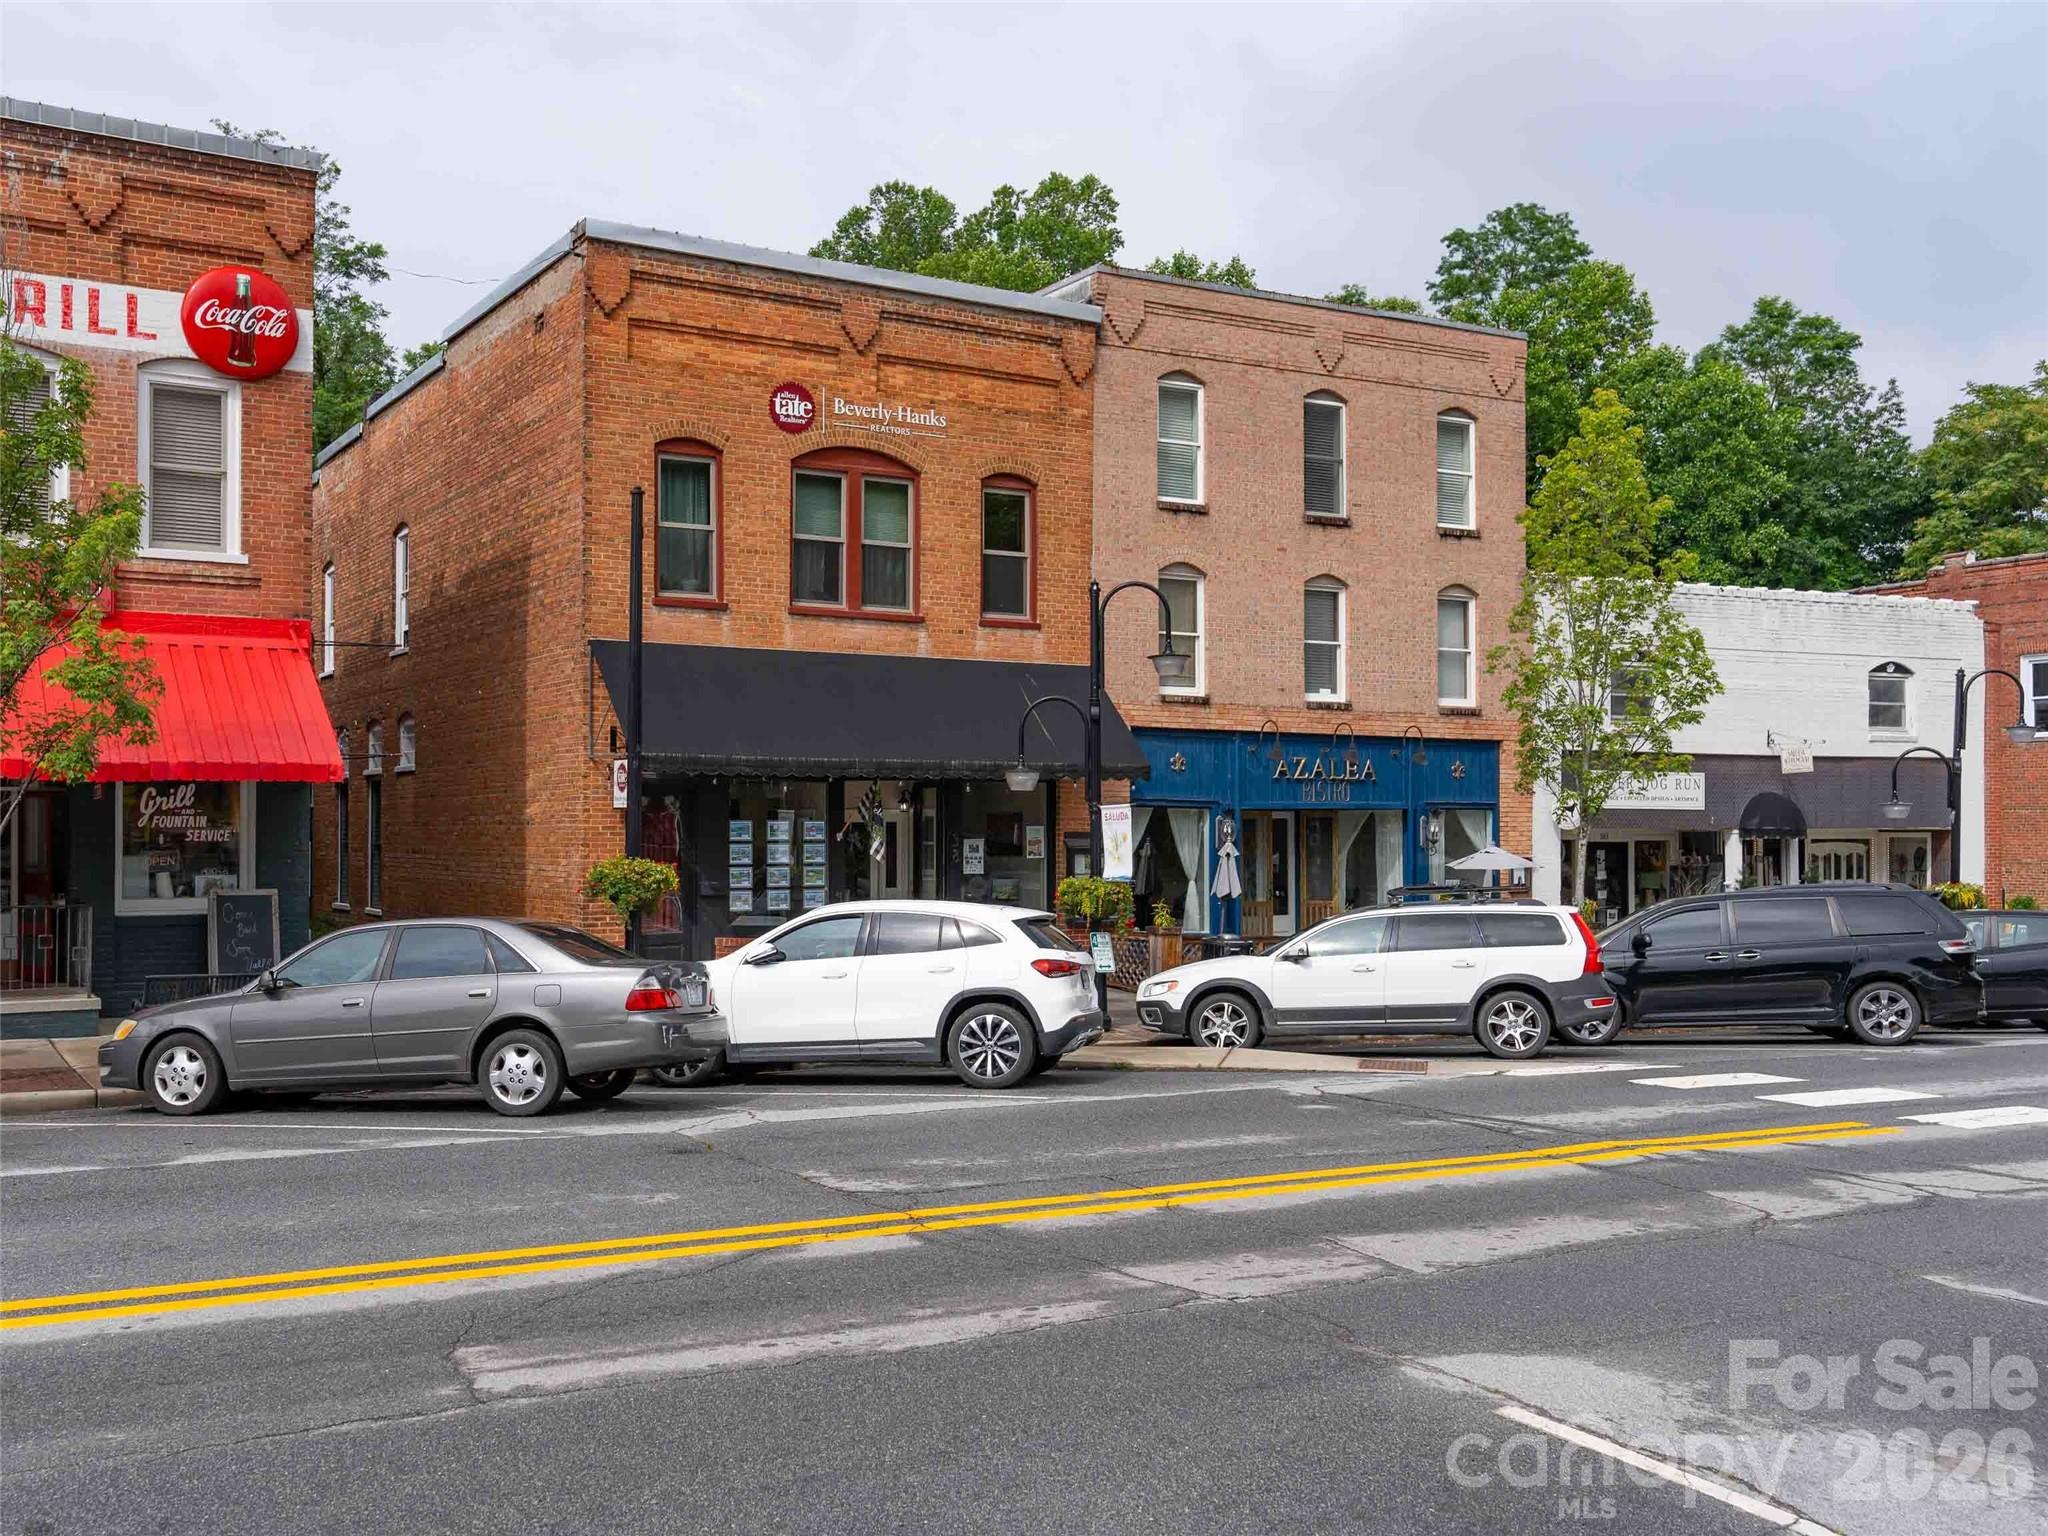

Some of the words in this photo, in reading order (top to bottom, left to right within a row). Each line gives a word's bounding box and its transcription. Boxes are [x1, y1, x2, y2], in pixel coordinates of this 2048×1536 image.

[13, 278, 157, 340] RILL
[195, 299, 288, 337] Coca-Cola
[773, 392, 813, 418] tate
[833, 397, 947, 427] Beverly-Hanks
[870, 424, 911, 435] REALTORS
[1272, 757, 1376, 780] AZALEA
[1302, 780, 1351, 802] BISTRO
[1641, 777, 1668, 790] DOG
[1675, 778, 1701, 790] RUN
[138, 783, 196, 828] Grill
[1104, 811, 1129, 821] SALUDA
[151, 815, 208, 828] FOUNTAIN
[184, 829, 231, 842] SERVICE
